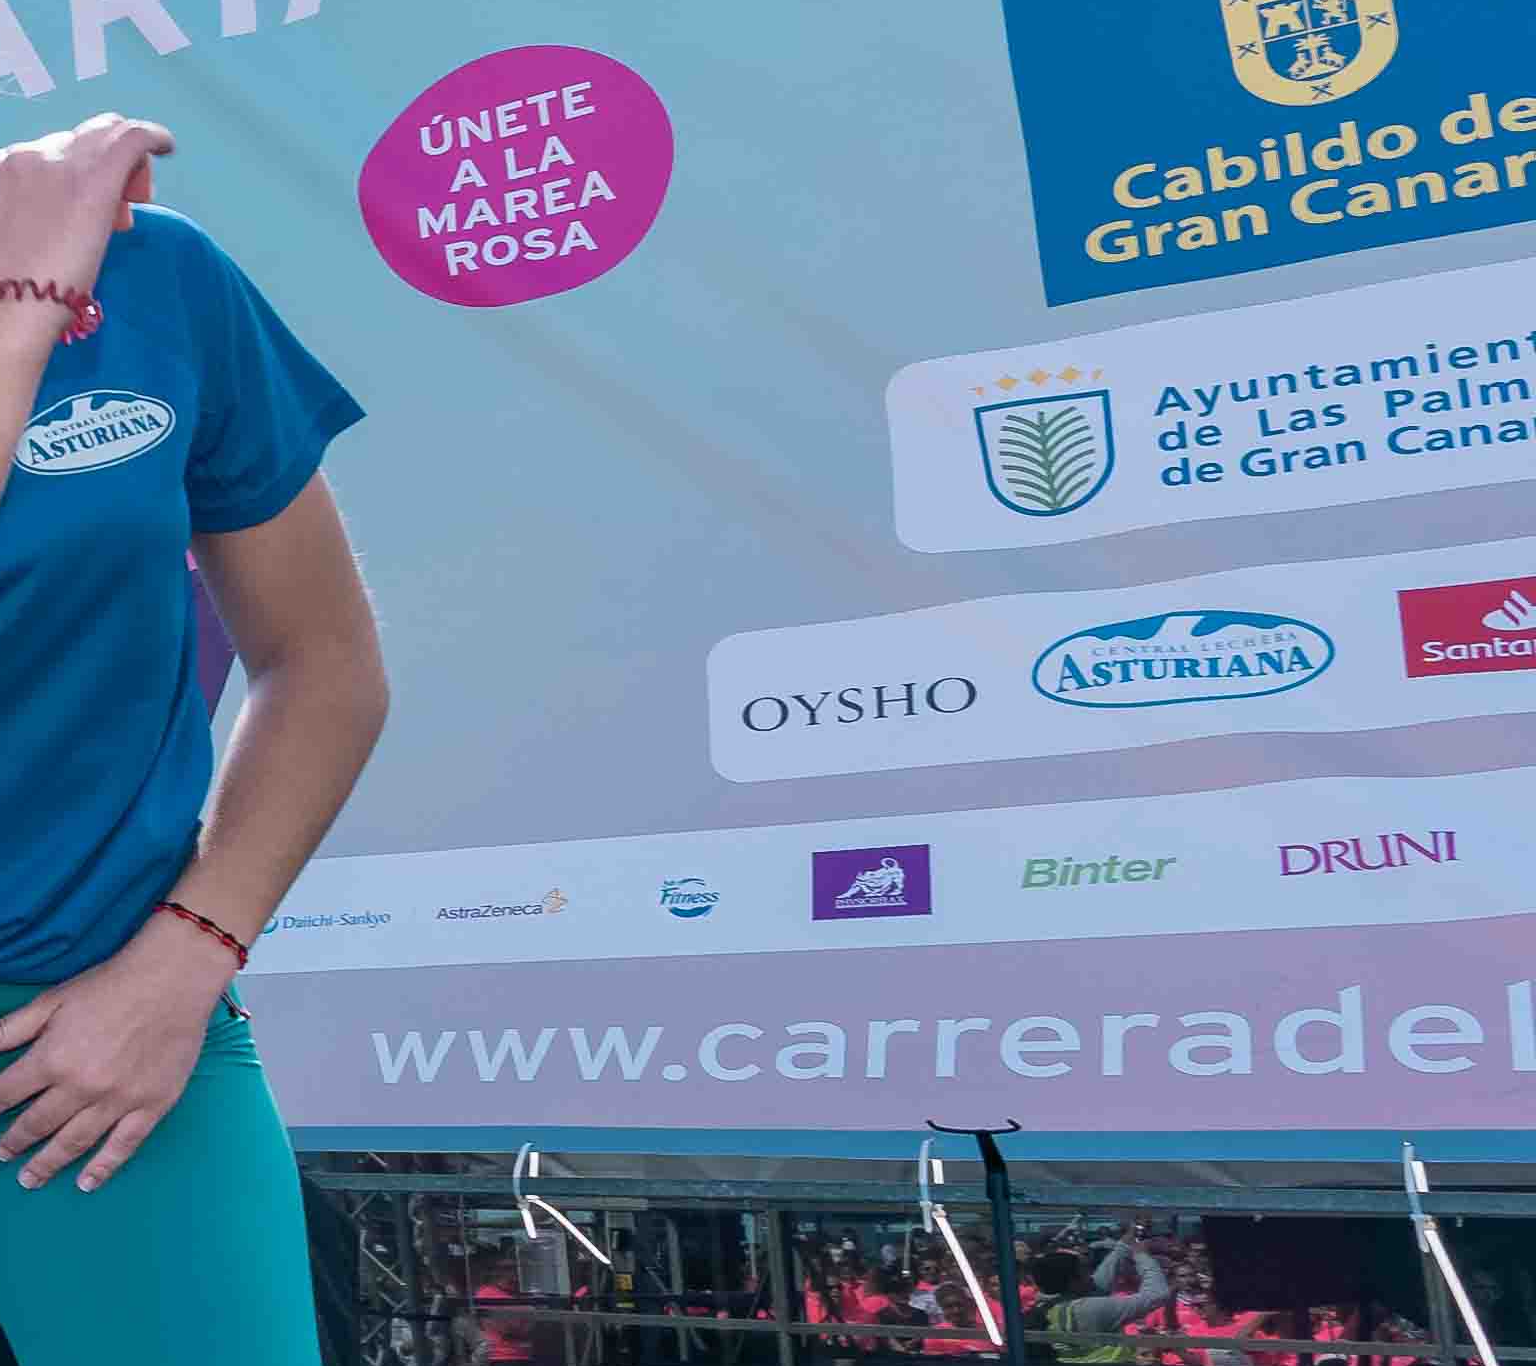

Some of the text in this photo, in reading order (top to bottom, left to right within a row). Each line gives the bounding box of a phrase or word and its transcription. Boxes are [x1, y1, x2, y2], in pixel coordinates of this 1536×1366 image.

[418, 81, 595, 156] ÚNETE
[449, 135, 575, 193] A LA
[1113, 91, 1536, 209] Cabildo de
[417, 170, 617, 239] MAREA
[1084, 202, 1269, 264] Gran
[445, 220, 599, 276] ROSA
[28, 413, 163, 465] ASTURIANA
[1157, 376, 1530, 452] de Las Palm
[1160, 415, 1536, 487] de Gran Cana
[1055, 645, 1315, 693] ASTURIANA
[1422, 636, 1536, 663] Santa
[742, 676, 978, 732] OYSHO
[1022, 855, 1177, 889] Binter
[1277, 830, 1457, 877] DRUNI
[436, 903, 544, 920] AstraZeneca
[372, 981, 1536, 1084] www.carreradel
